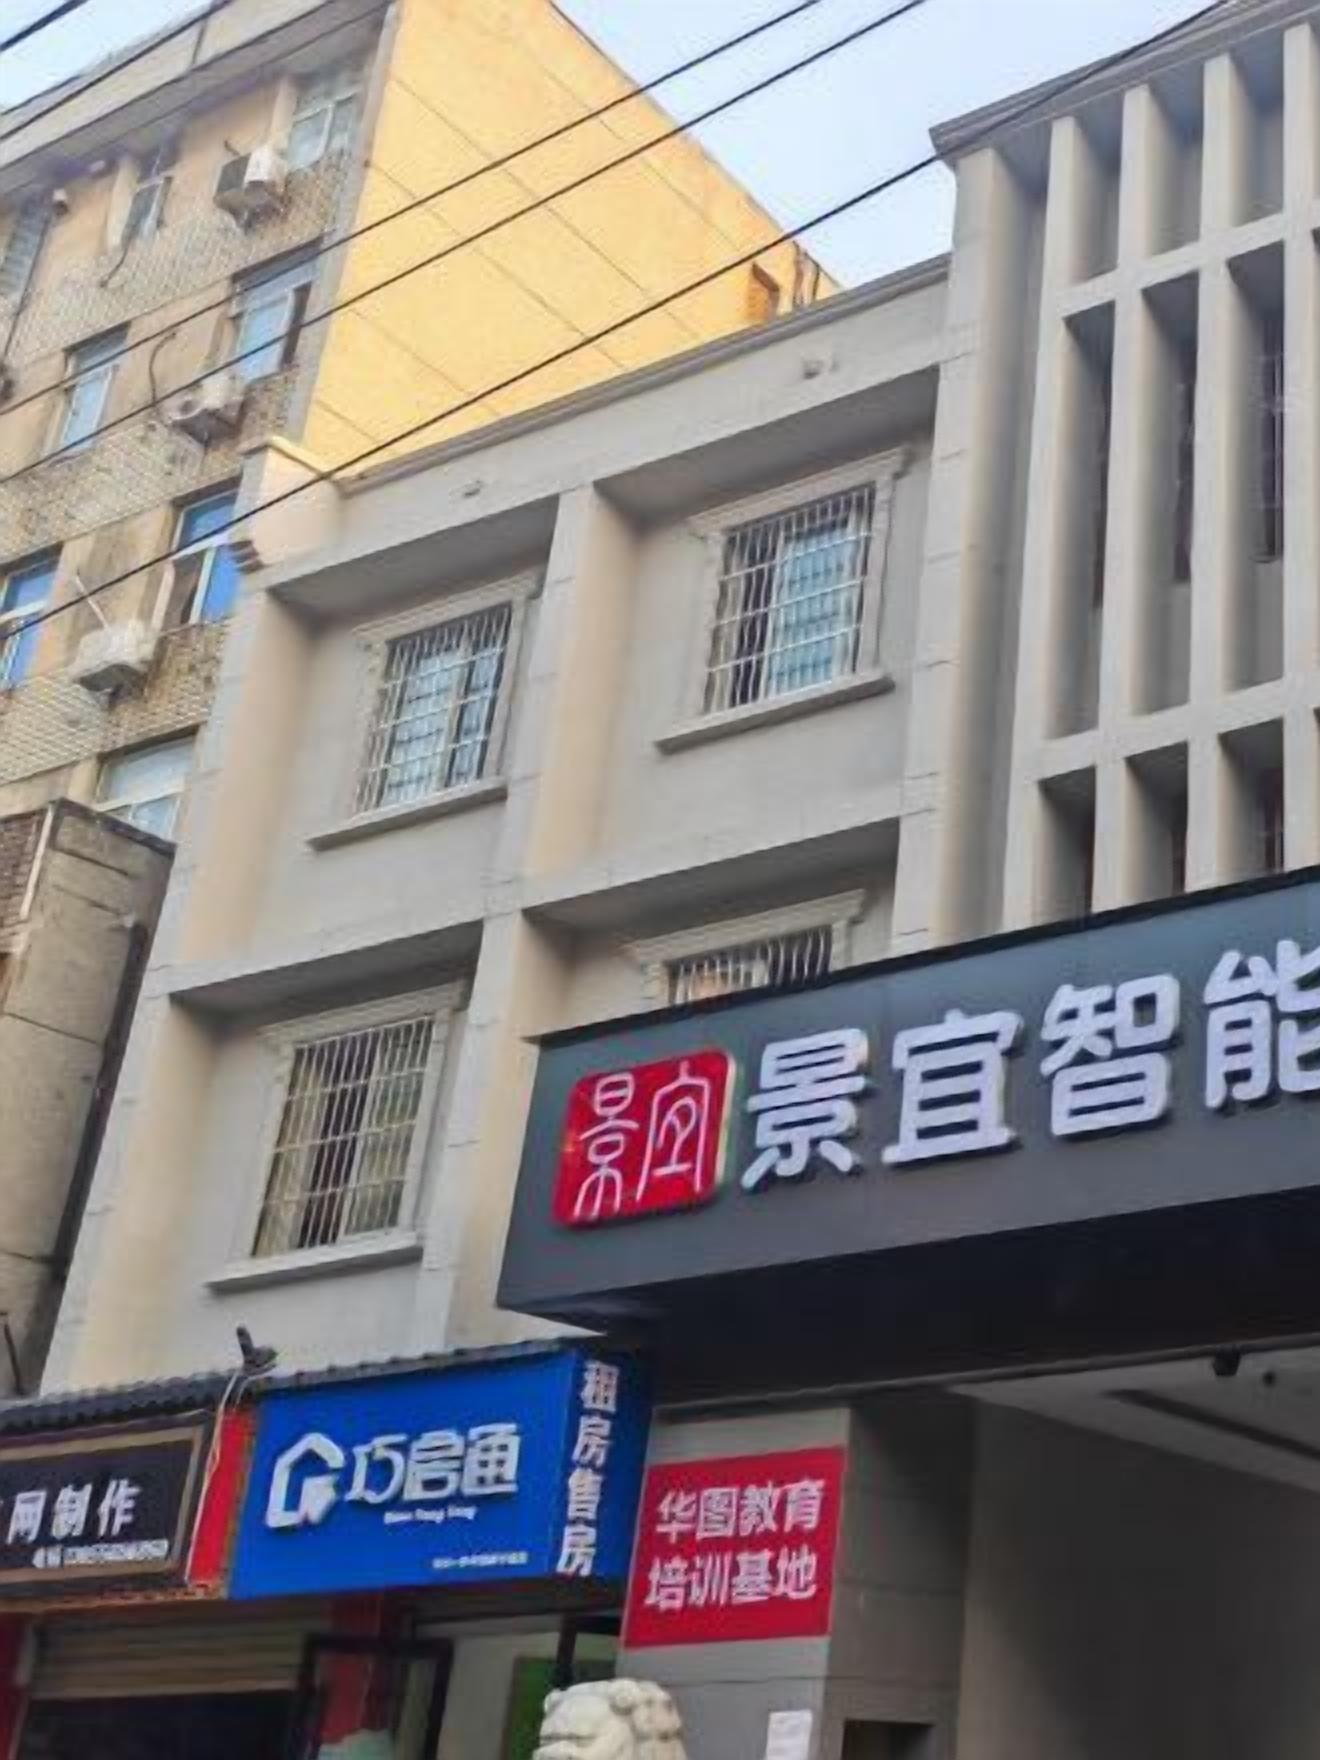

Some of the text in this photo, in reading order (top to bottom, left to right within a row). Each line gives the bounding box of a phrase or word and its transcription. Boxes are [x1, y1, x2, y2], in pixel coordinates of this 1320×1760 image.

[656, 1477, 825, 1544] 华图教育
[644, 1544, 818, 1613] 培训基地
